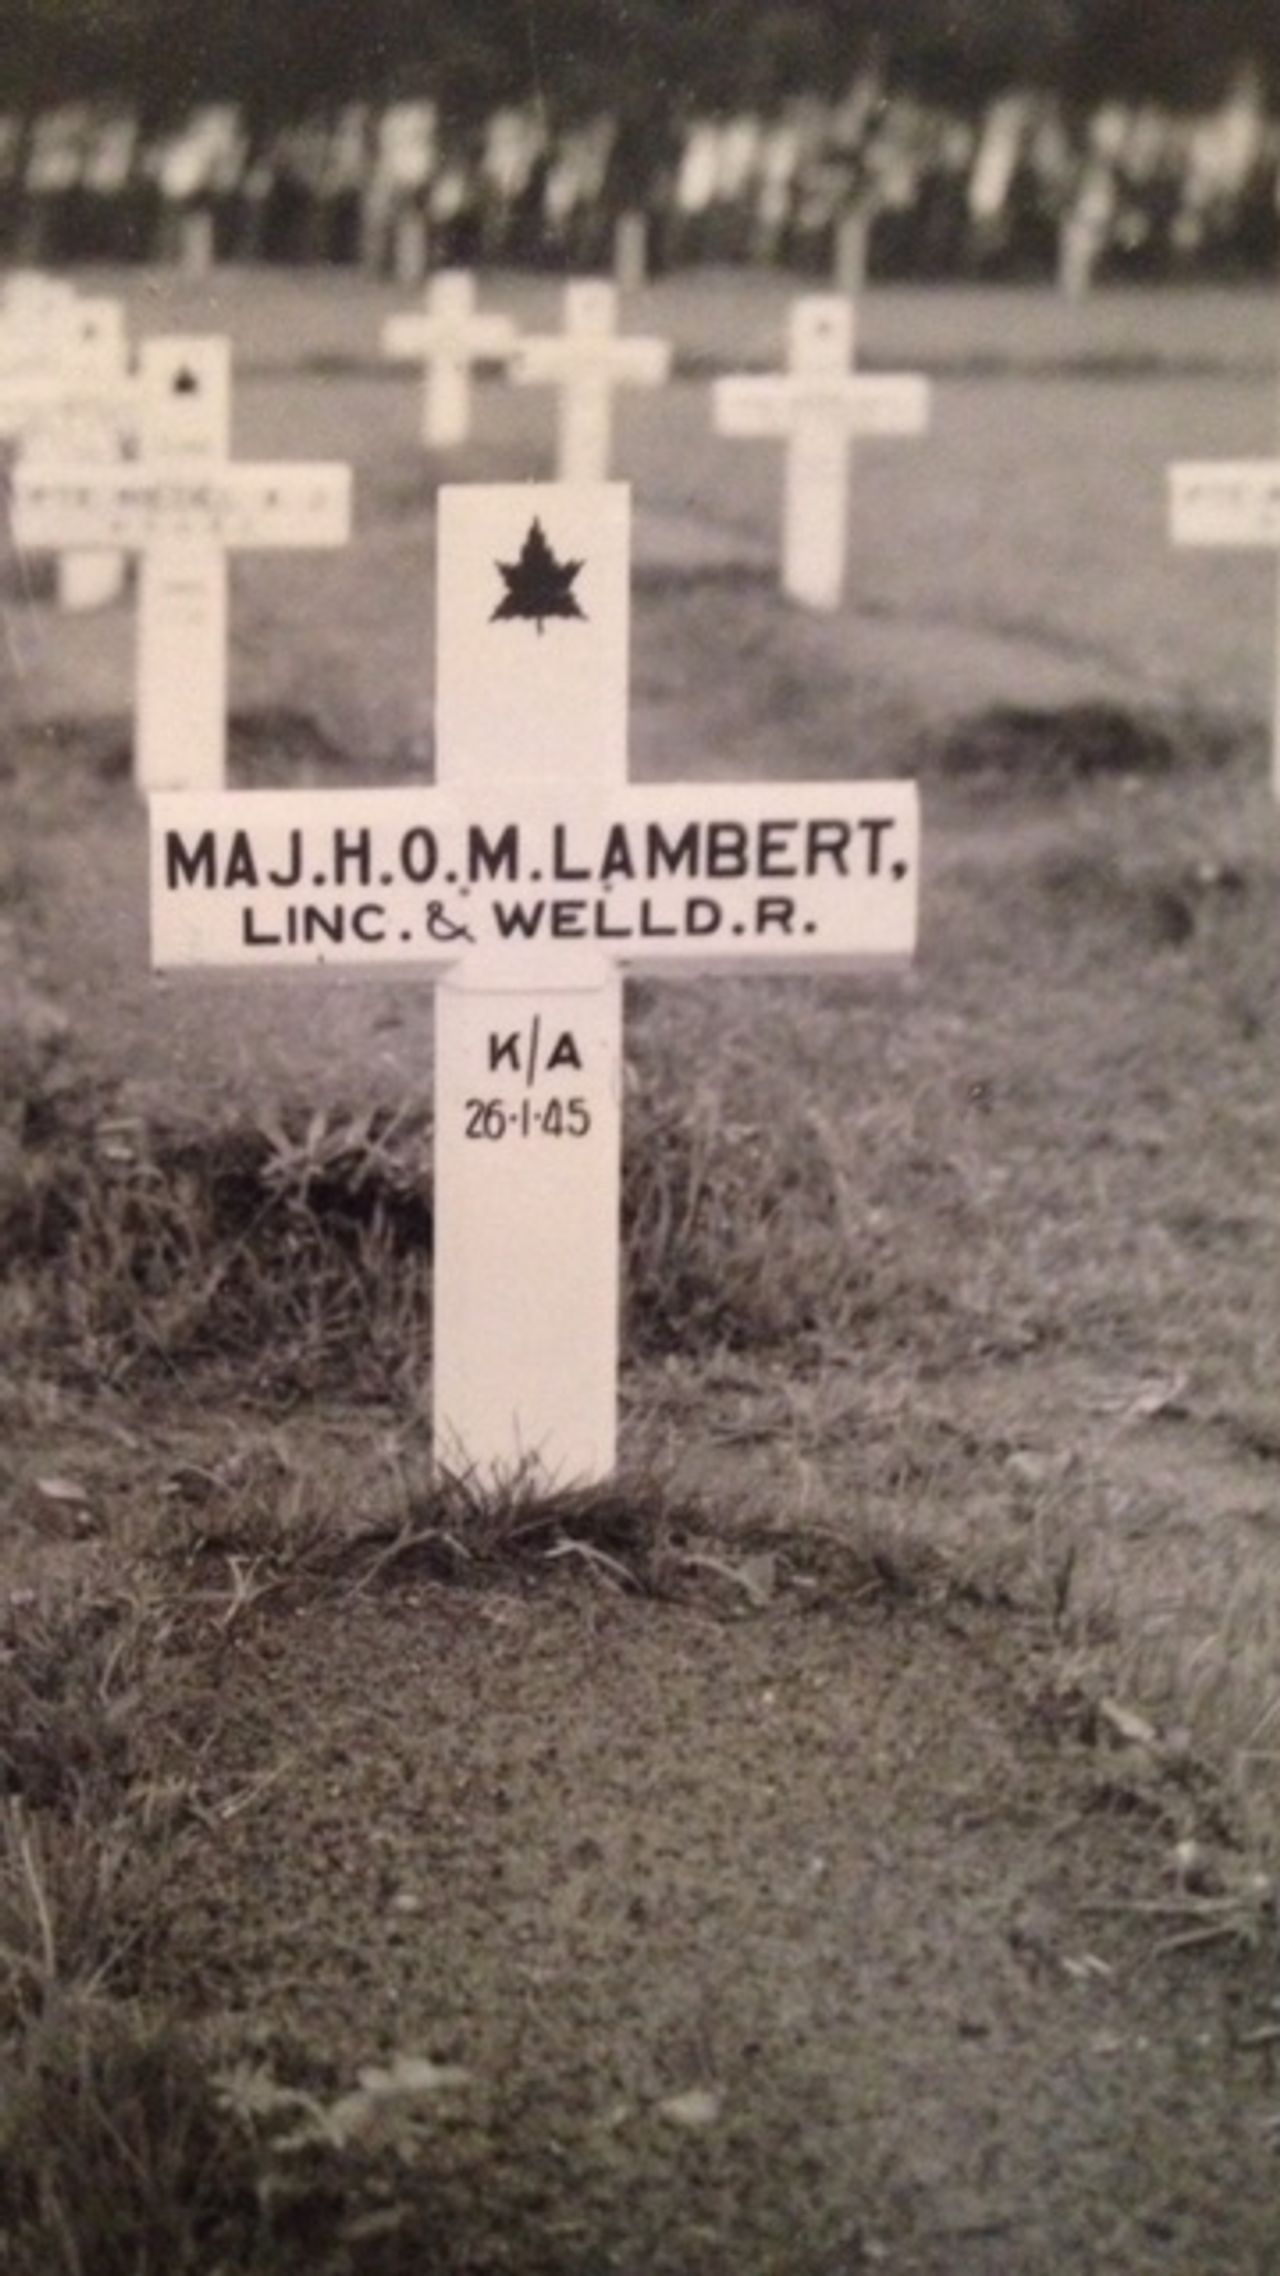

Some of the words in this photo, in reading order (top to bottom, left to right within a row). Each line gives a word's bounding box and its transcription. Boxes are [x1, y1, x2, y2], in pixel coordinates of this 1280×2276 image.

[242, 903, 411, 947] LINC.
[426, 900, 475, 943] &
[488, 1014, 582, 1086] K/A
